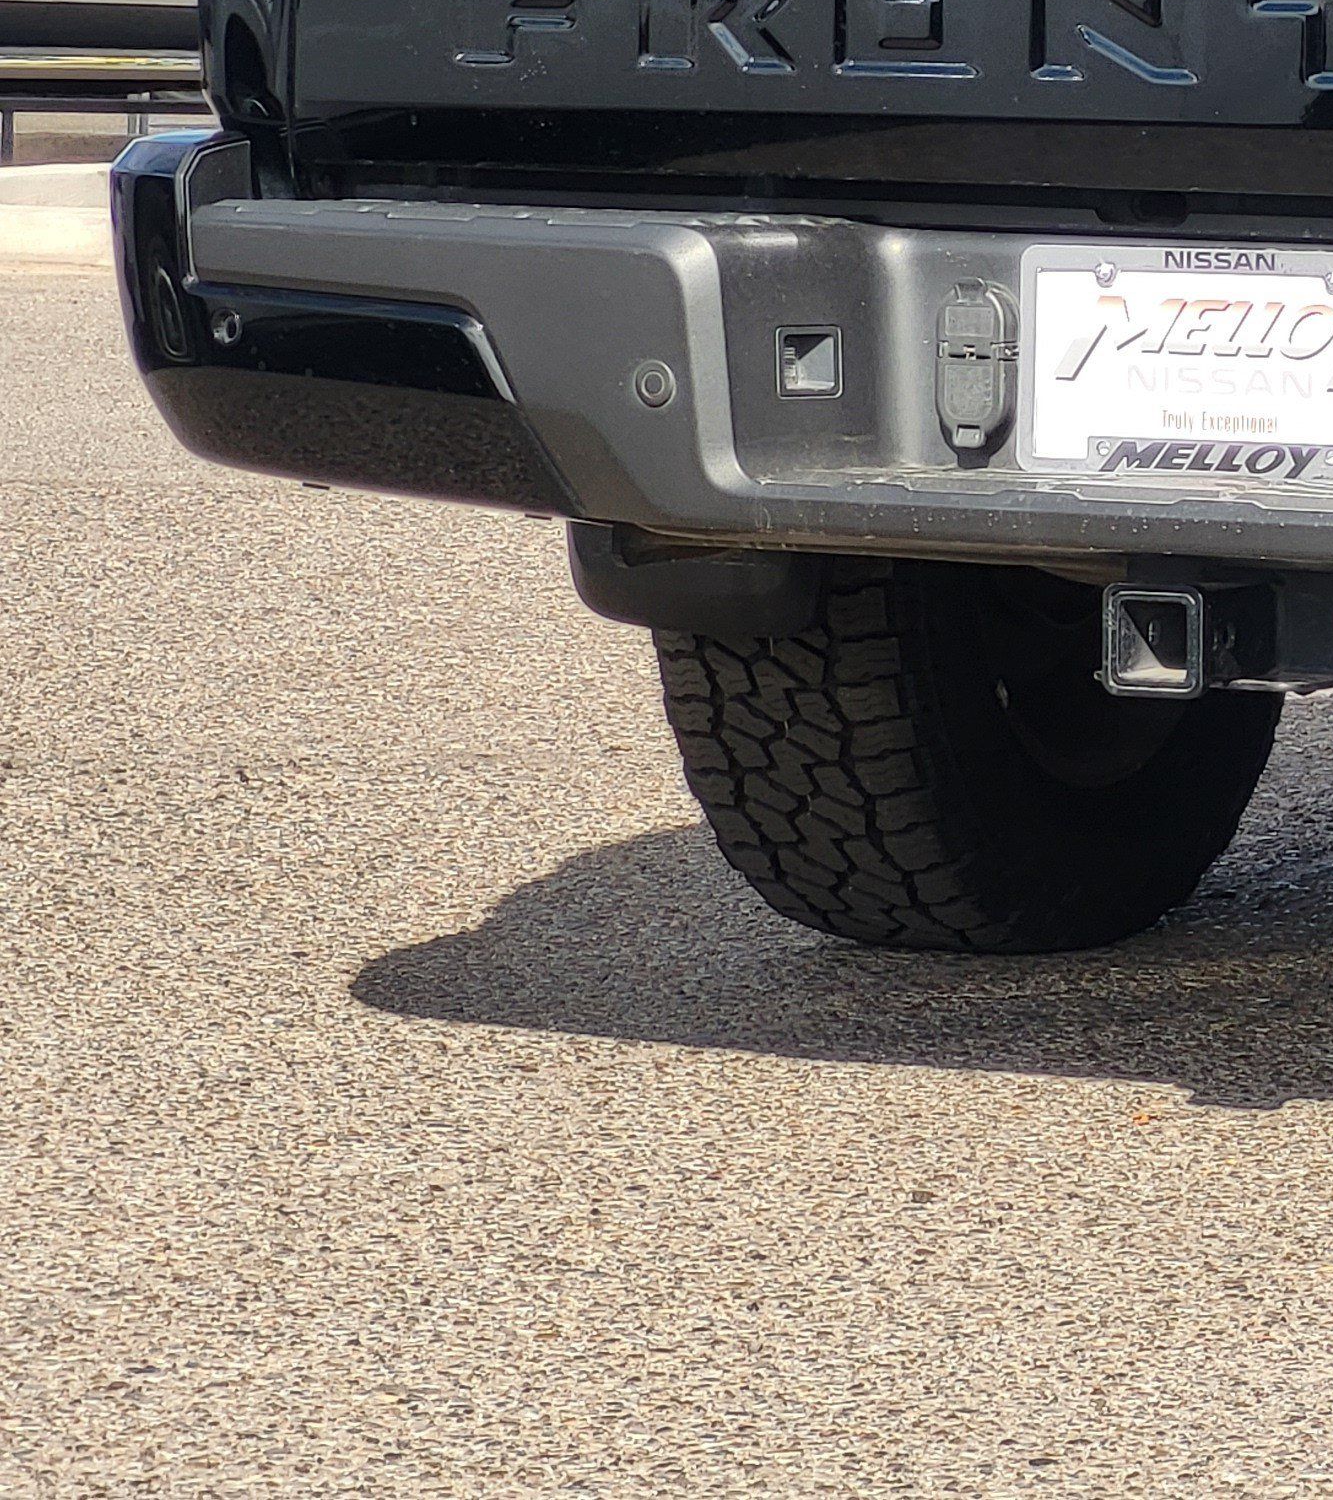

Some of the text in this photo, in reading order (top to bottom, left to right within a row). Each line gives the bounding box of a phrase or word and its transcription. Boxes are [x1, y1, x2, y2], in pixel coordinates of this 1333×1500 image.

[1164, 250, 1276, 272] NISSAN
[1126, 364, 1313, 399] NISSAN
[1161, 408, 1279, 434] Truly Exceptional
[1100, 440, 1321, 479] MELLOY
